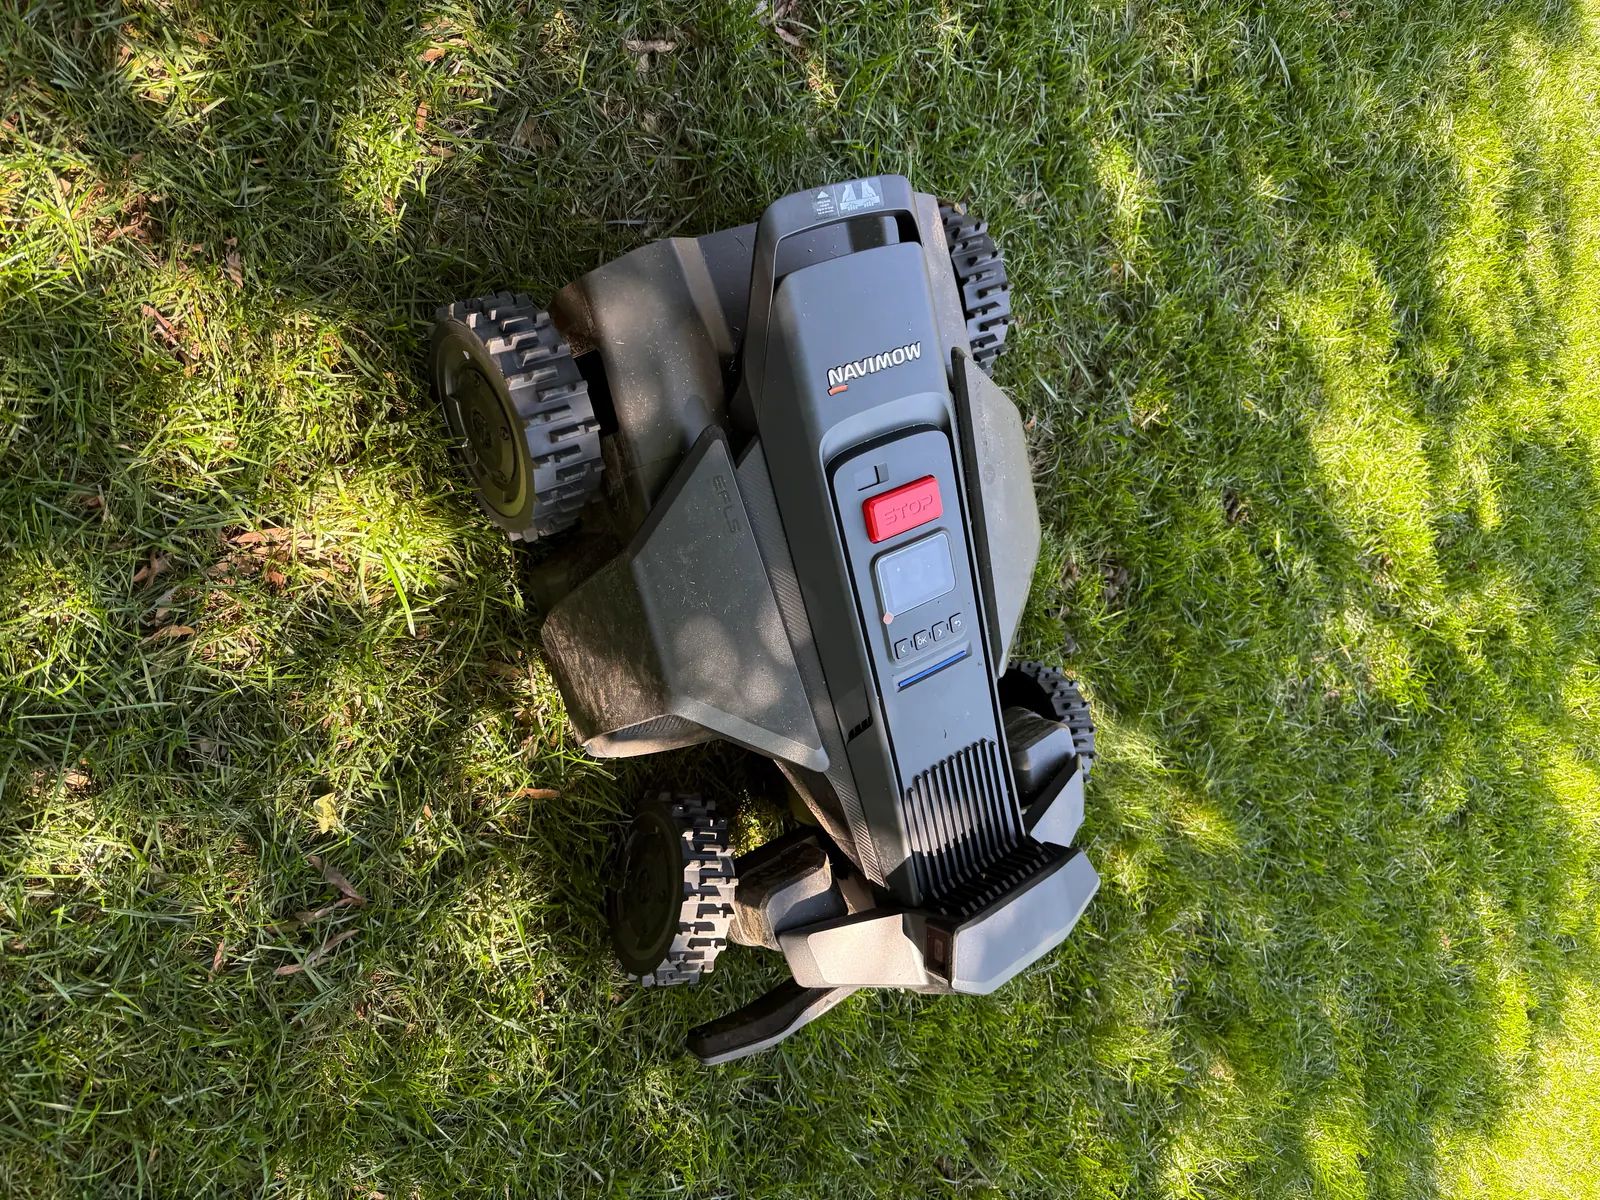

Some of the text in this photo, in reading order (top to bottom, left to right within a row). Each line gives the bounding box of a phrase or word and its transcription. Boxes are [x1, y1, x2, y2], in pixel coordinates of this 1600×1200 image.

[827, 341, 921, 387] NAVIMOW
[712, 474, 741, 533] EFLS
[884, 494, 934, 526] STOP
[917, 635, 928, 646] OK
